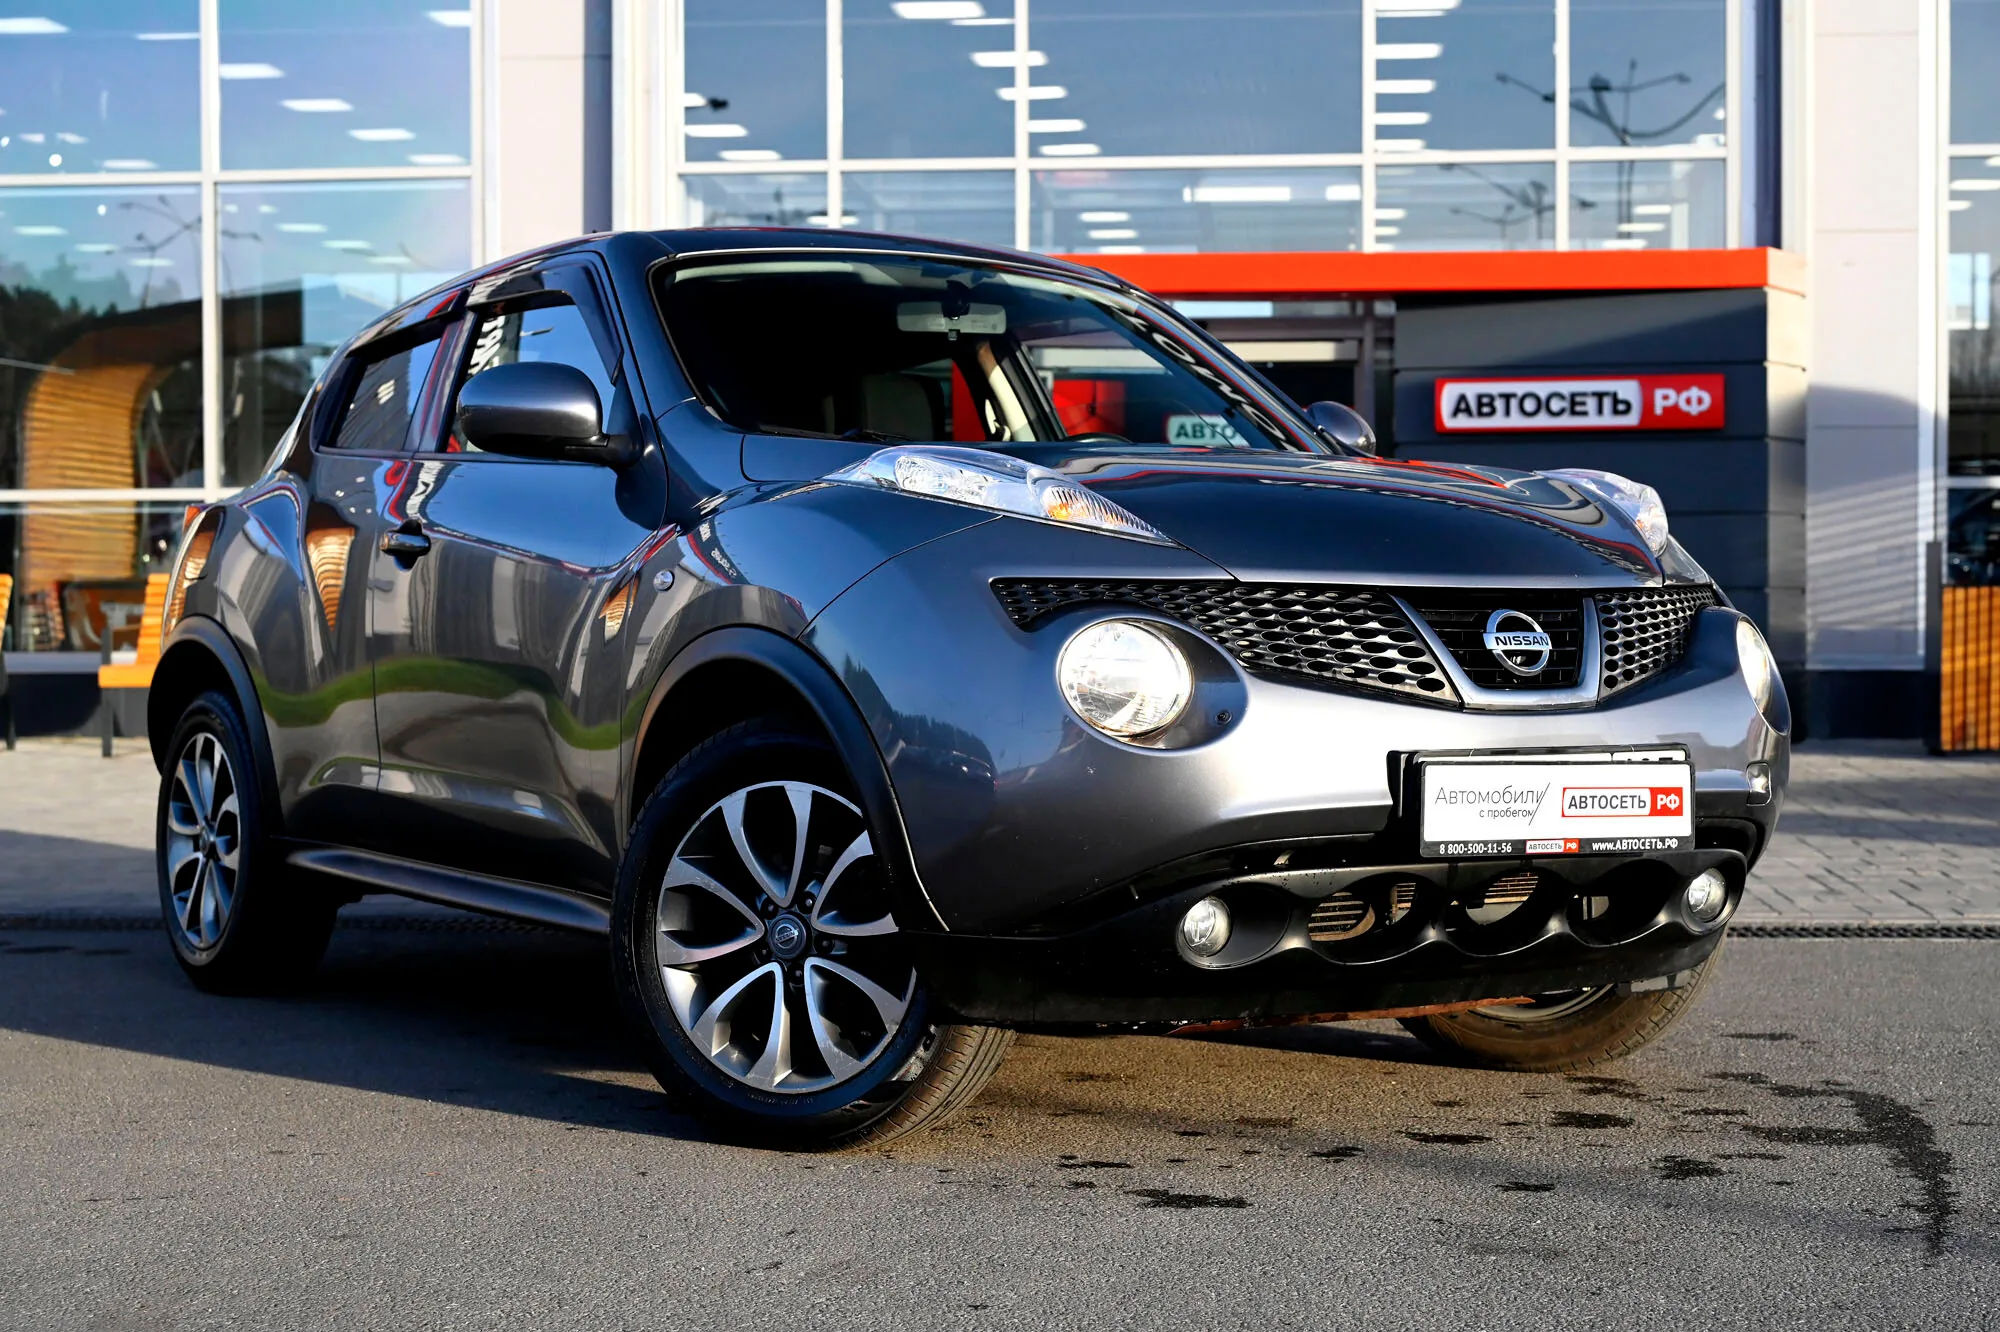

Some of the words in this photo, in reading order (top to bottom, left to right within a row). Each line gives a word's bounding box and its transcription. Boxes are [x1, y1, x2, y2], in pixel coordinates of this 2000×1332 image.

[1451, 390, 1633, 418] АВТОСЕТЬ
[1653, 386, 1712, 416] РФ
[1494, 635, 1549, 646] NISSAN
[1434, 784, 1544, 805] Автомобили
[1567, 795, 1647, 810] АВТОСЕТЬ
[1656, 793, 1680, 811] РФ
[1479, 809, 1485, 818] с
[1487, 806, 1535, 820] пробегом
[1439, 843, 1446, 855] 8
[1447, 842, 1512, 854] 800-500-11-56
[1528, 841, 1562, 851] АВТОСЕТЬ
[1565, 841, 1578, 850] РФ
[1591, 838, 1679, 851] www.АВТОСЕТЬ.РФ
